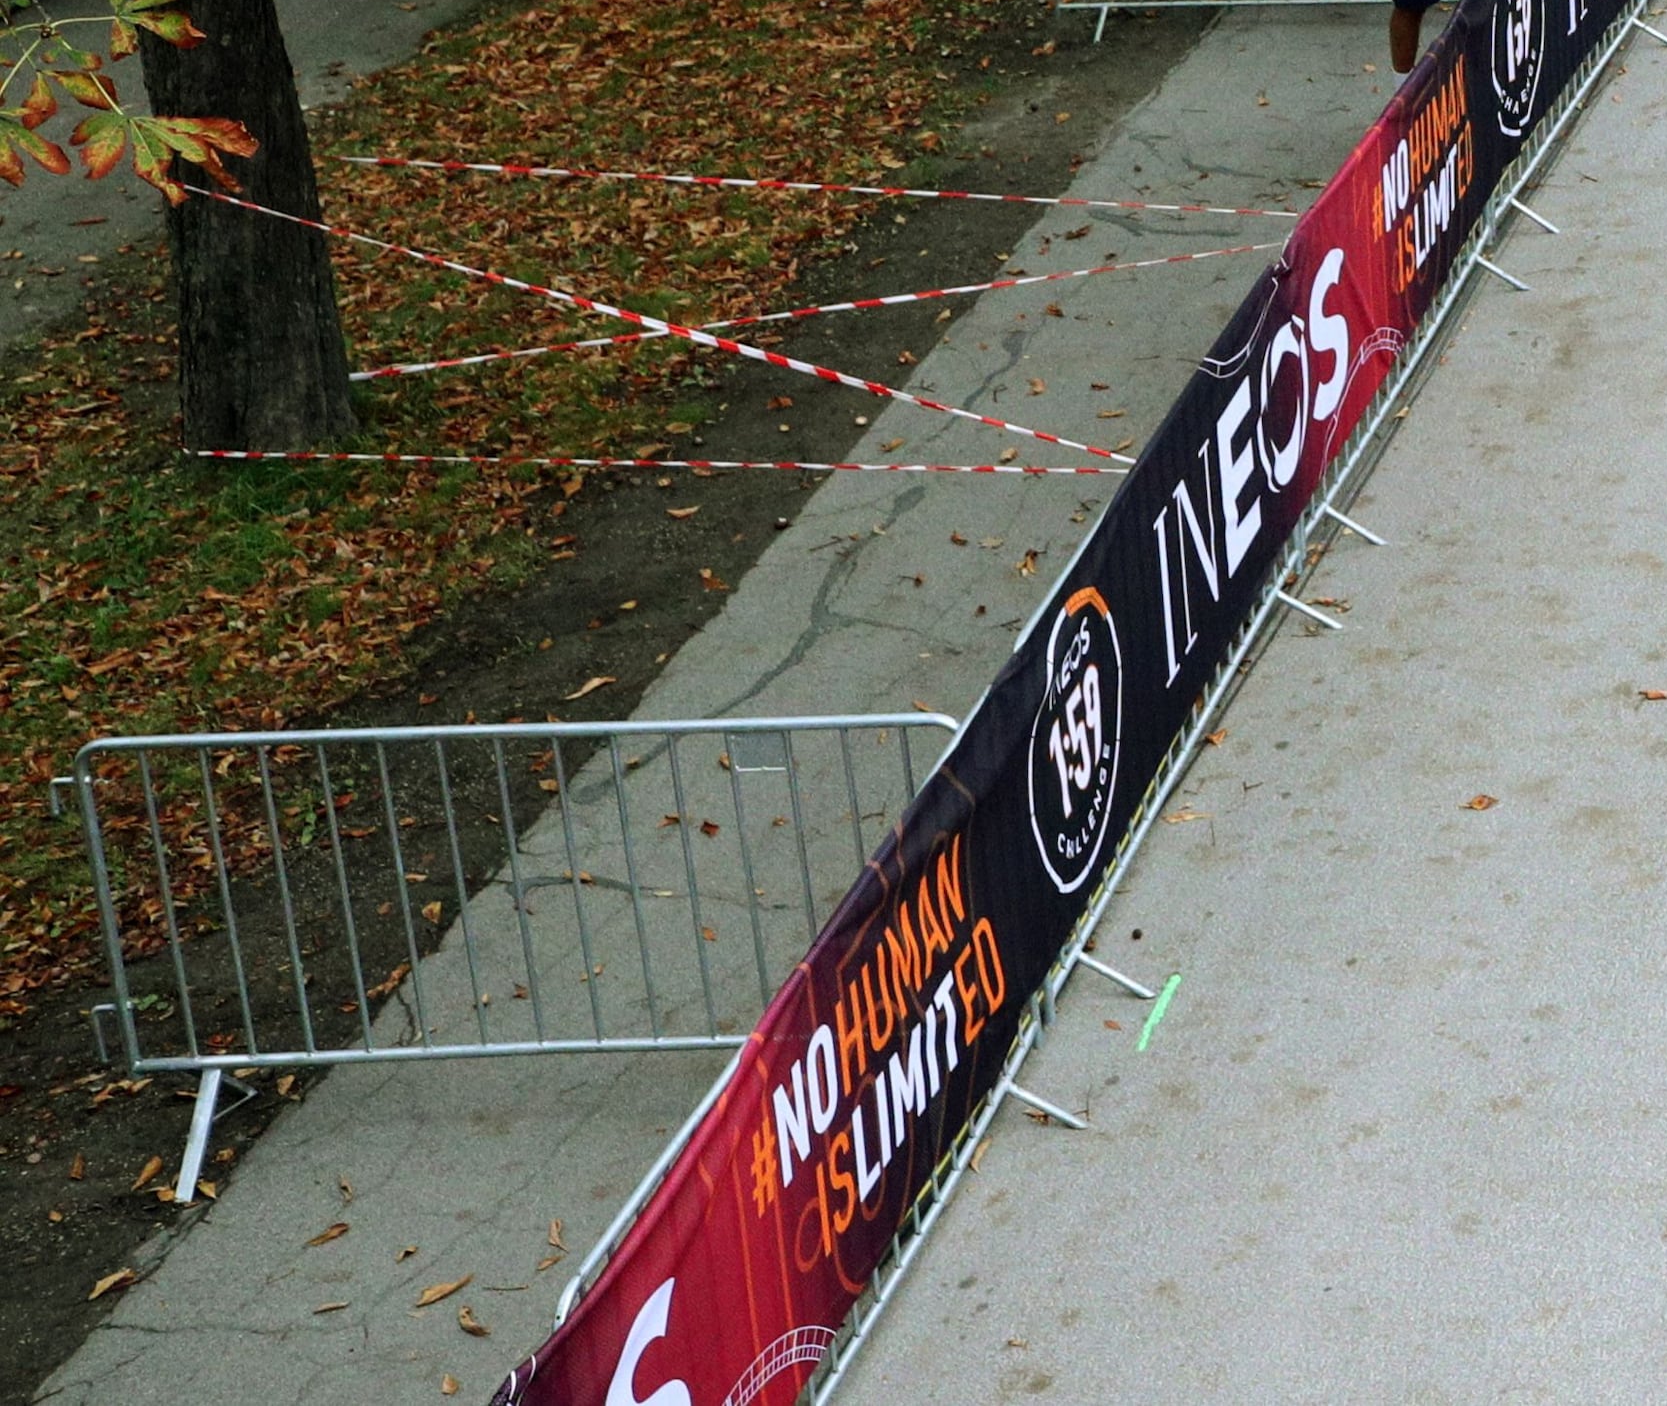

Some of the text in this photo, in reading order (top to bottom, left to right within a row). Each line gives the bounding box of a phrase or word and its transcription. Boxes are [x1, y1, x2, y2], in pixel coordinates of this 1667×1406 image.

[1373, 54, 1466, 243] #NOHUMAN
[1396, 119, 1473, 295] ISLIMITED
[1153, 247, 1350, 690] INEOS
[1048, 663, 1103, 819] 1:59
[751, 832, 966, 1218] #NOHUMAN
[815, 916, 1006, 1257] ISLIMITED
